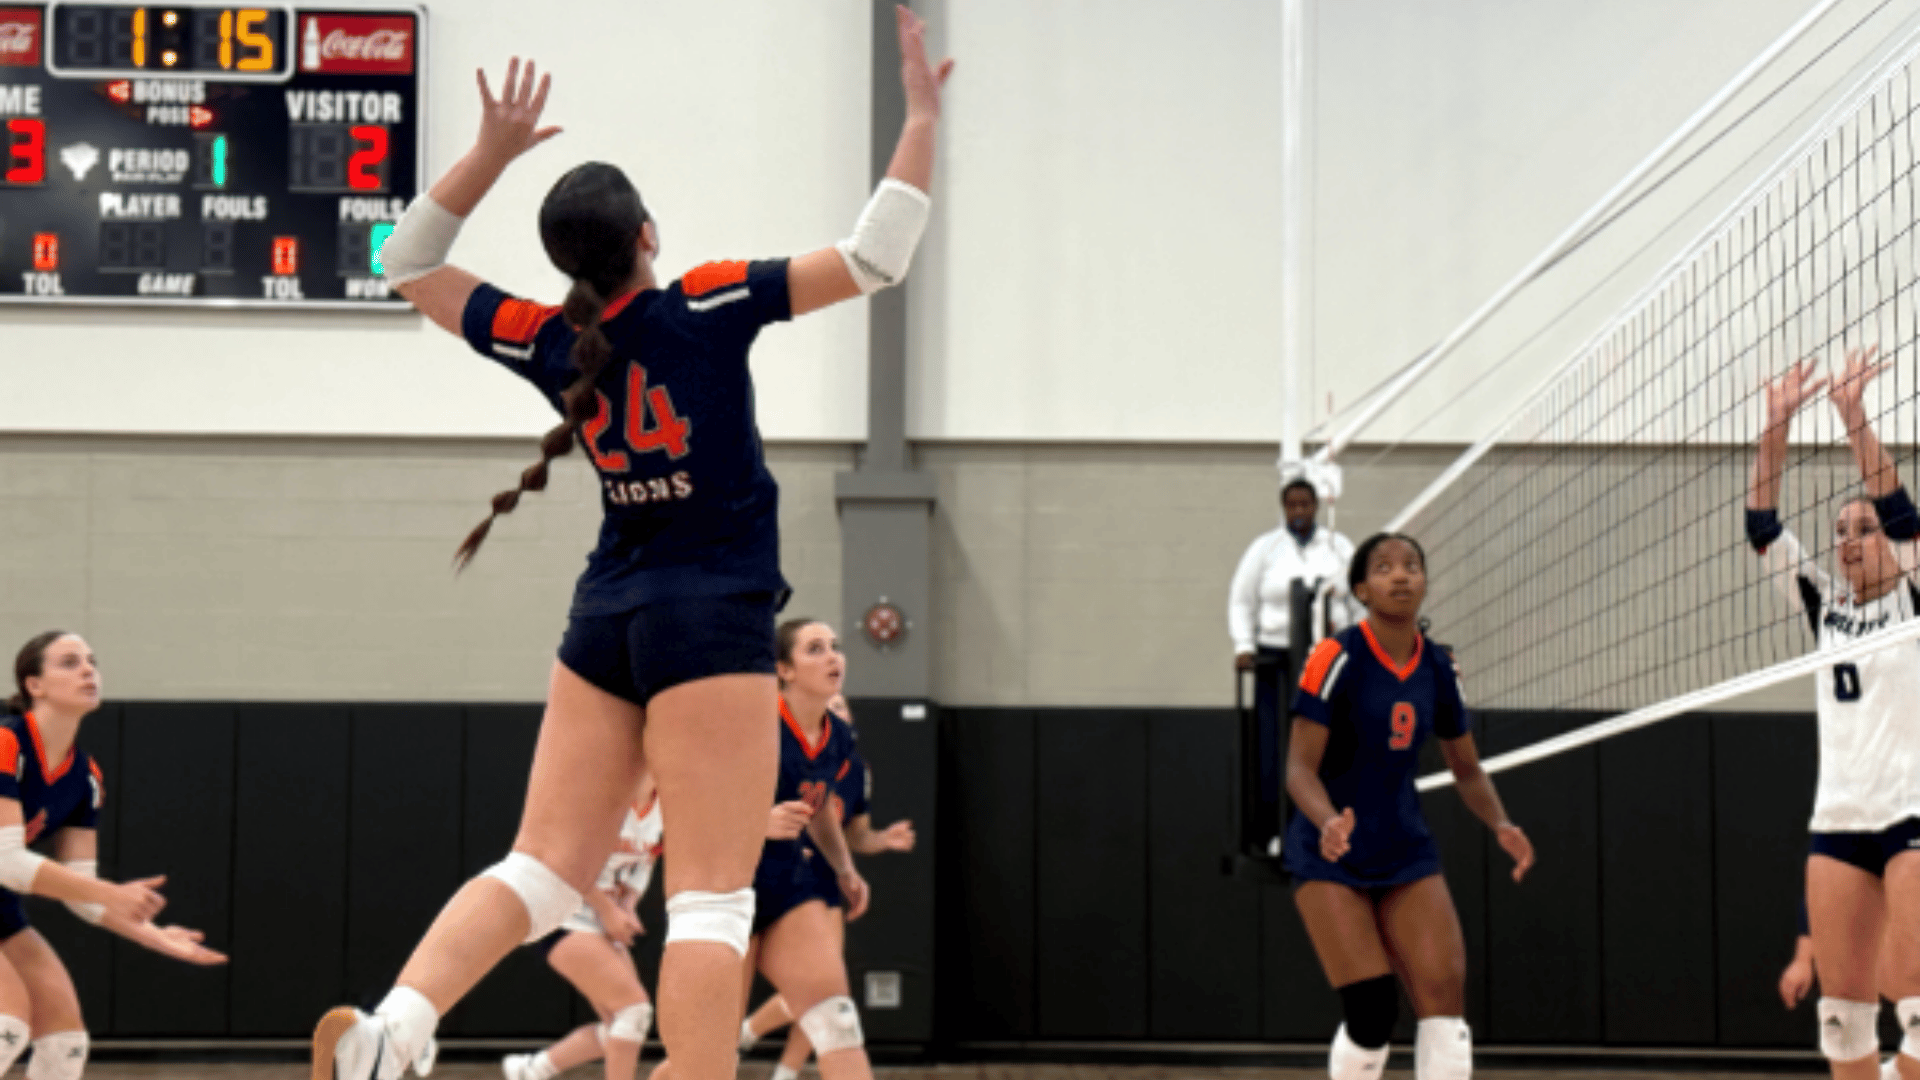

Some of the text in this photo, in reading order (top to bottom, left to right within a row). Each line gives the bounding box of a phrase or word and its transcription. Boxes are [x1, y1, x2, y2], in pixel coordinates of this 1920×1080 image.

[133, 80, 206, 103] BONUS
[286, 90, 402, 122] VISITOR
[6, 118, 46, 184] 3
[108, 148, 190, 173] PERIOD
[211, 135, 228, 188] 1
[347, 125, 390, 190] 2
[100, 193, 181, 218] PLAYER
[203, 197, 267, 220] FOULS
[339, 197, 404, 220] FOULS
[22, 272, 65, 296] TOL
[138, 273, 196, 296] GAME
[262, 276, 305, 299] TOL
[580, 360, 692, 473] 24
[1833, 663, 1862, 702] 0
[1388, 701, 1416, 750] 9
